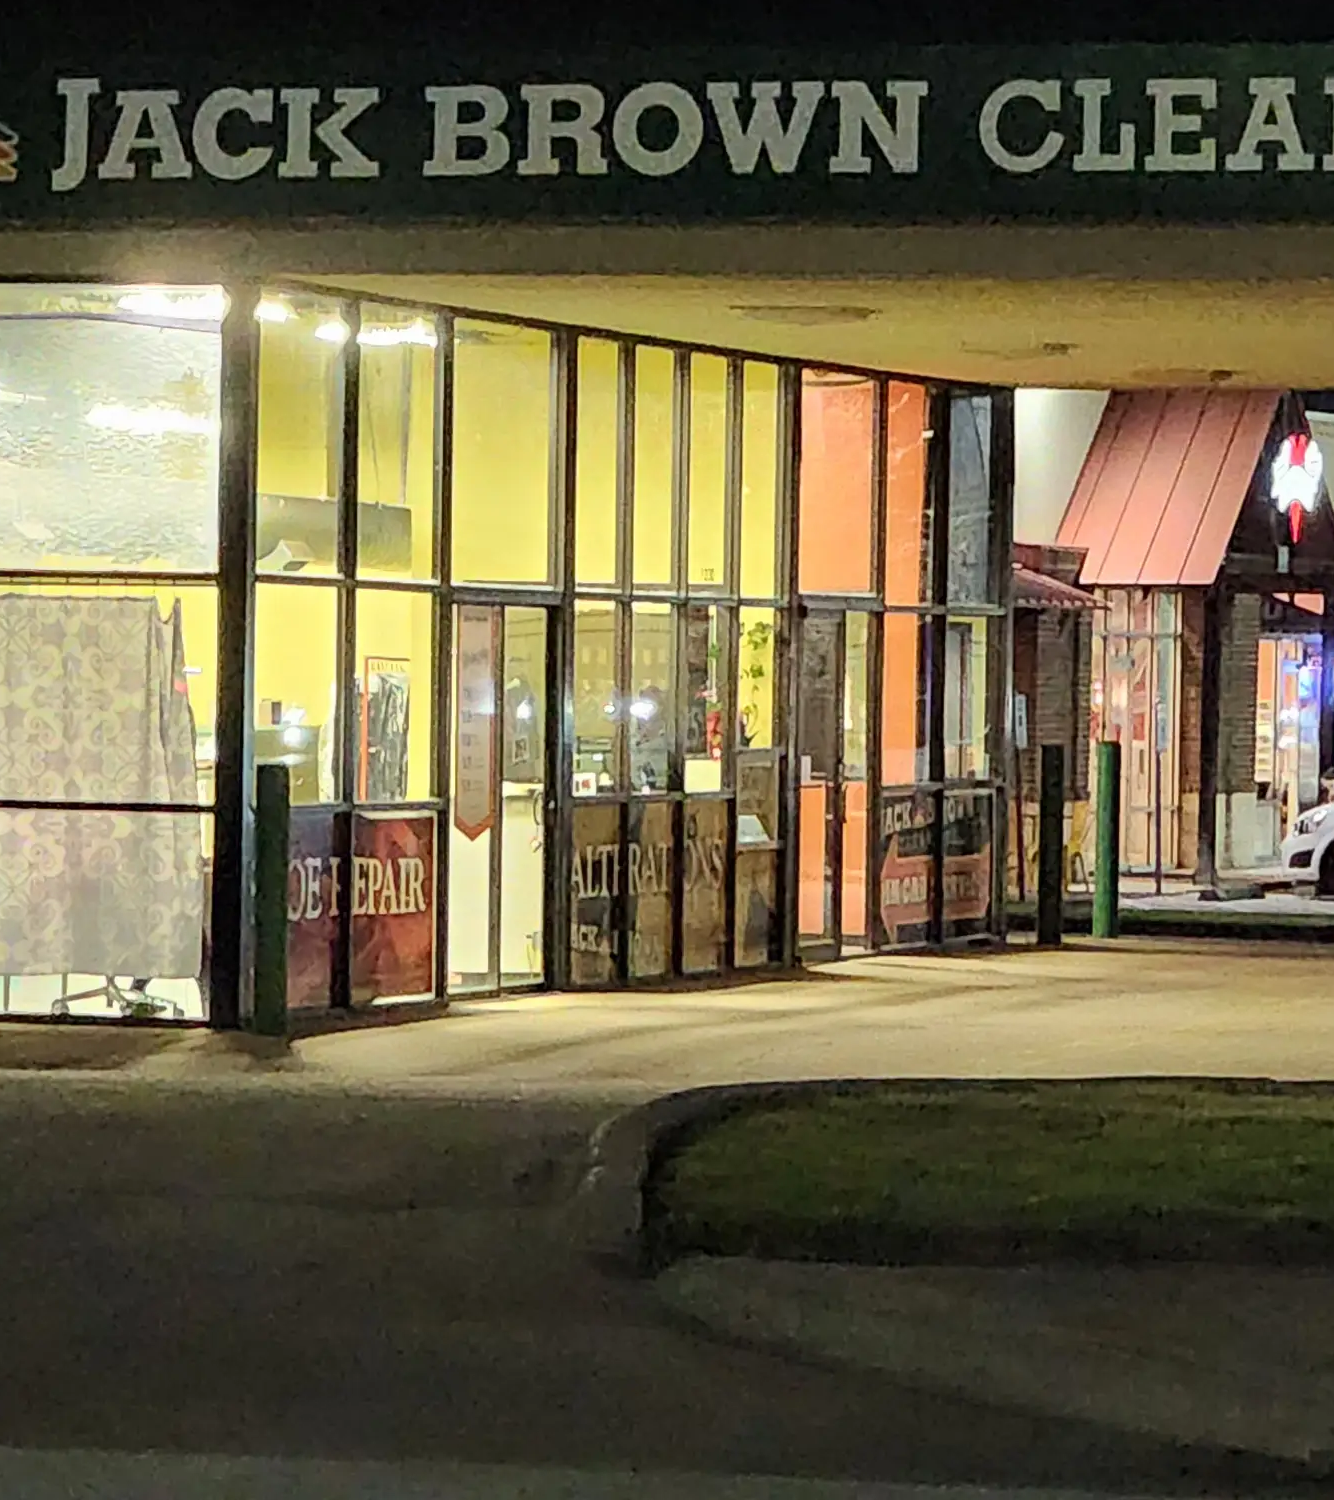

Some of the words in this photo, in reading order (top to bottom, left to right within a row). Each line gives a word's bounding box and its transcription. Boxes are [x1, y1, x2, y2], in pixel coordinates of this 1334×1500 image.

[50, 76, 381, 193] JACK
[422, 78, 930, 180] BROWN
[570, 837, 724, 899] ALTRATONS
